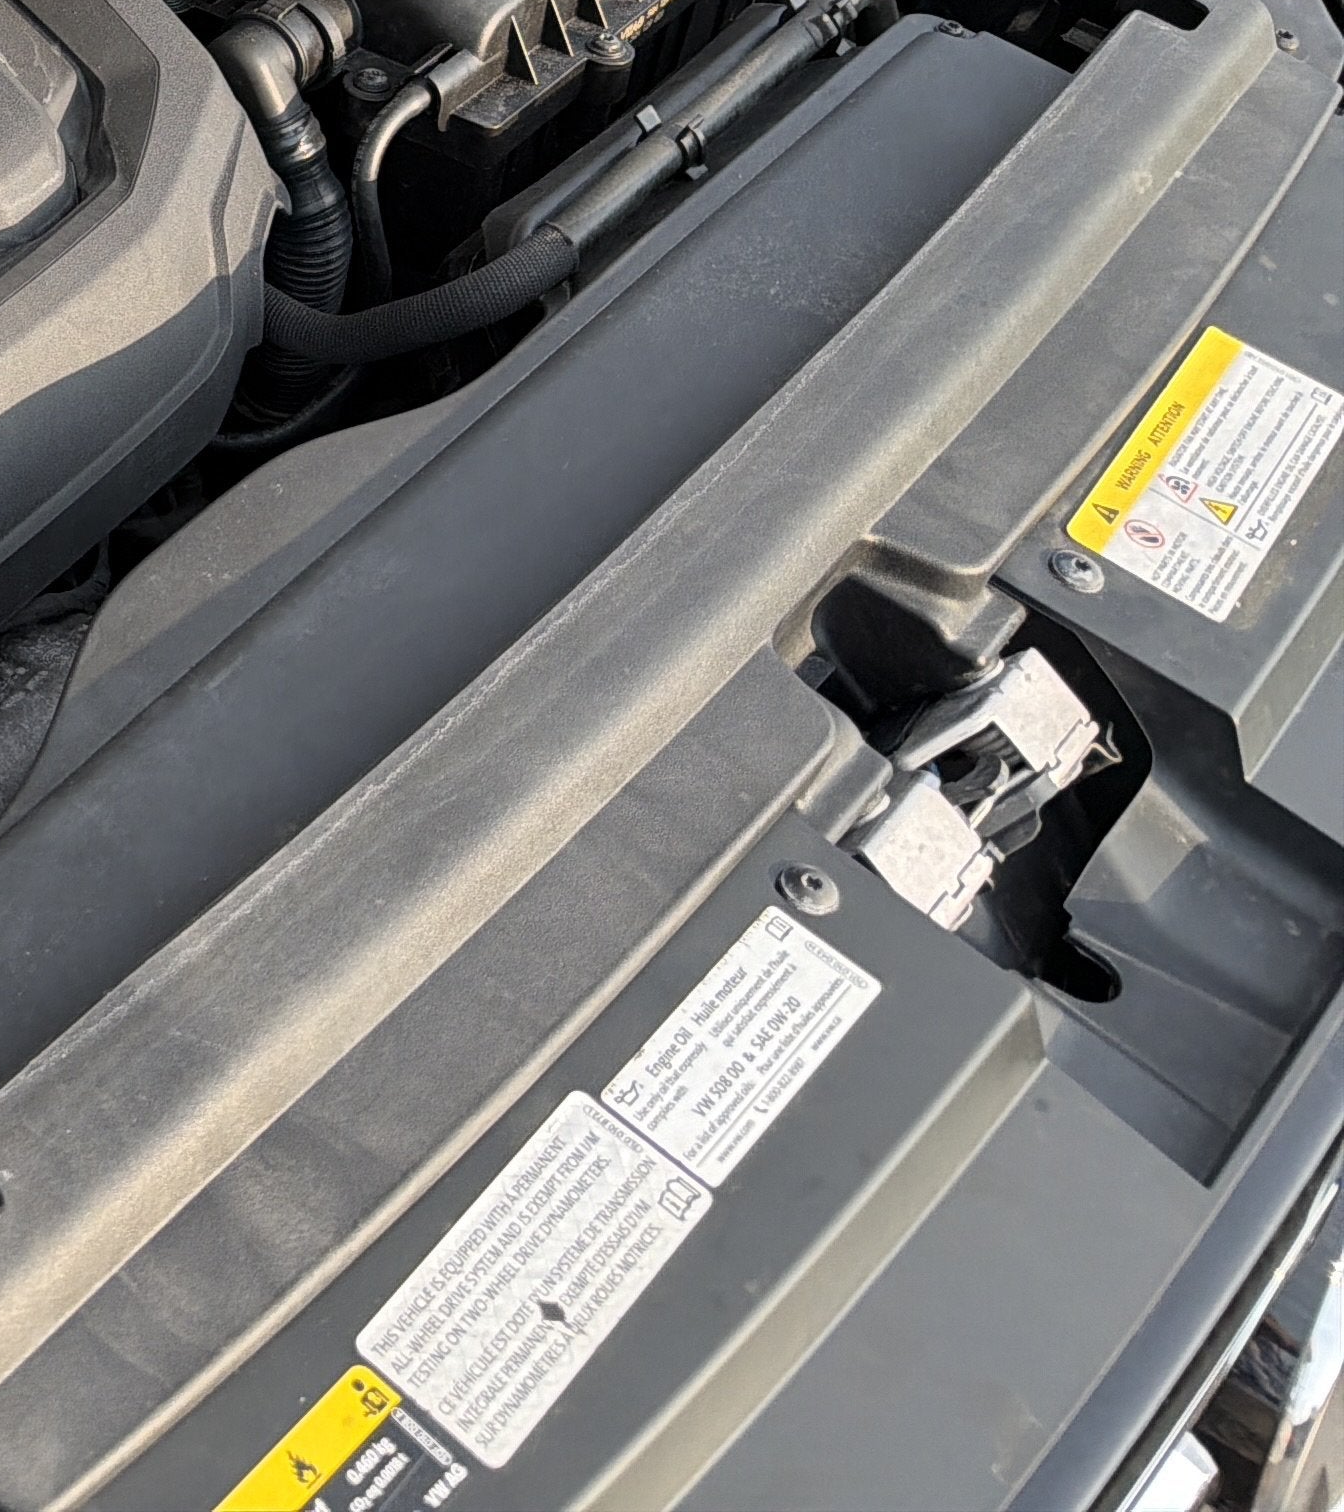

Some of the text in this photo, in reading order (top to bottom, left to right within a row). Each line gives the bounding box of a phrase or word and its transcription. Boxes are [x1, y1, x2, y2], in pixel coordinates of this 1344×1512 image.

[1114, 401, 1185, 491] WARNING ATTENTION
[643, 1039, 685, 1081] Engine
[670, 1024, 694, 1047] Oil
[710, 964, 749, 1003] moteur
[690, 993, 802, 1119] VW 508 00 & SAE 0W-20
[555, 1146, 587, 1180] FROM
[515, 1209, 533, 1226] IS
[523, 1173, 564, 1217] EXEMPT
[592, 1154, 657, 1228] TRANSMISSION
[370, 1134, 569, 1360] THIS VEHICLE IS EQUIPPED WITH A PERMANENT
[494, 1219, 525, 1251] AND
[582, 1220, 603, 1241] DE
[462, 1242, 504, 1288] SYSTEM
[406, 1339, 453, 1391] TESTING
[443, 1321, 468, 1348] ON
[458, 1258, 521, 1330] TWO-WHEEL
[511, 1230, 545, 1266] DRIVE
[436, 1280, 472, 1318] DRIVE
[388, 1310, 446, 1375] ALL-WHEEL
[472, 1418, 503, 1450] SUR
[588, 1267, 625, 1308] ROUES
[488, 1327, 514, 1353] EST
[499, 1312, 558, 1380] PERMANEN
[435, 1395, 457, 1417] CE
[421, 1458, 471, 1511] VW AG
